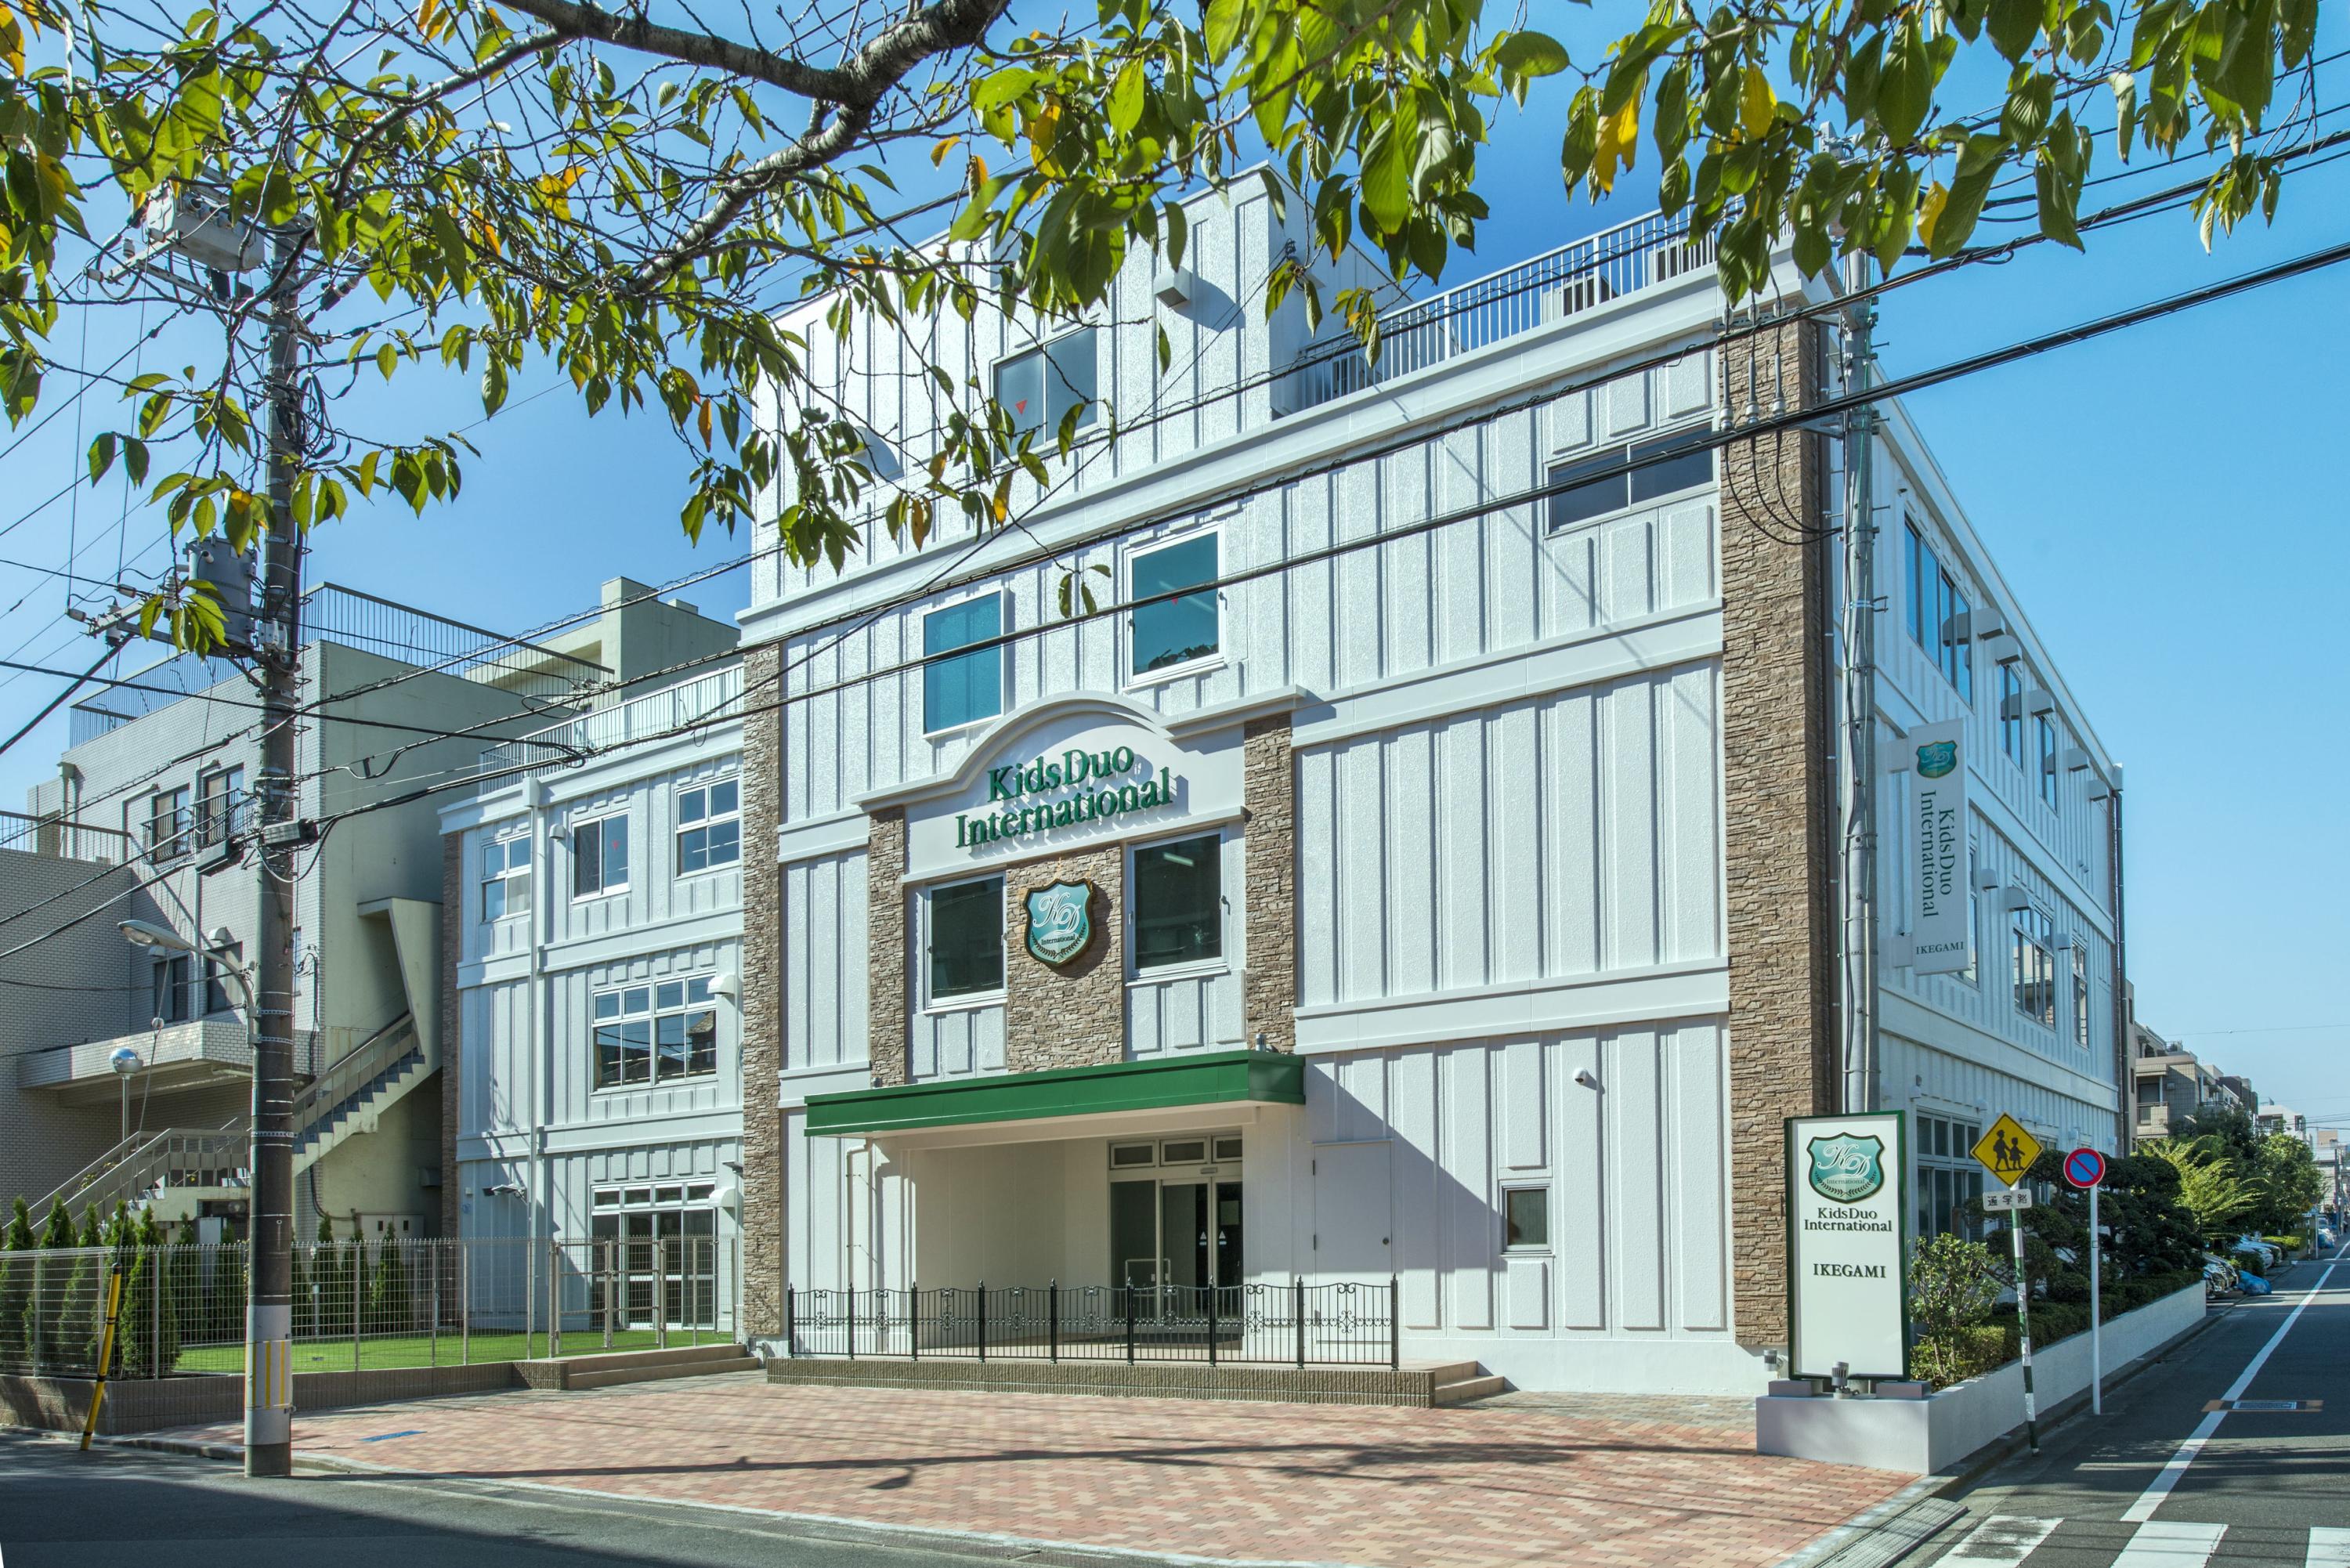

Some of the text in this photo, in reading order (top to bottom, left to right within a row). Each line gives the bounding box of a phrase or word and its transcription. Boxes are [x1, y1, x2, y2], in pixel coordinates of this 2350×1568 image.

[988, 746, 1135, 802] KidsDuo
[956, 767, 1173, 849] International
[1921, 789, 1939, 918] International
[1938, 807, 1956, 896] KidsDuo
[1041, 934, 1076, 945] International
[1916, 941, 1965, 956] IKEGAMI
[1987, 1194, 2027, 1207] 通学路
[1817, 1207, 1878, 1219] KidsDuo
[1804, 1219, 1893, 1232] International
[1813, 1263, 1886, 1278] IKEGAMI
